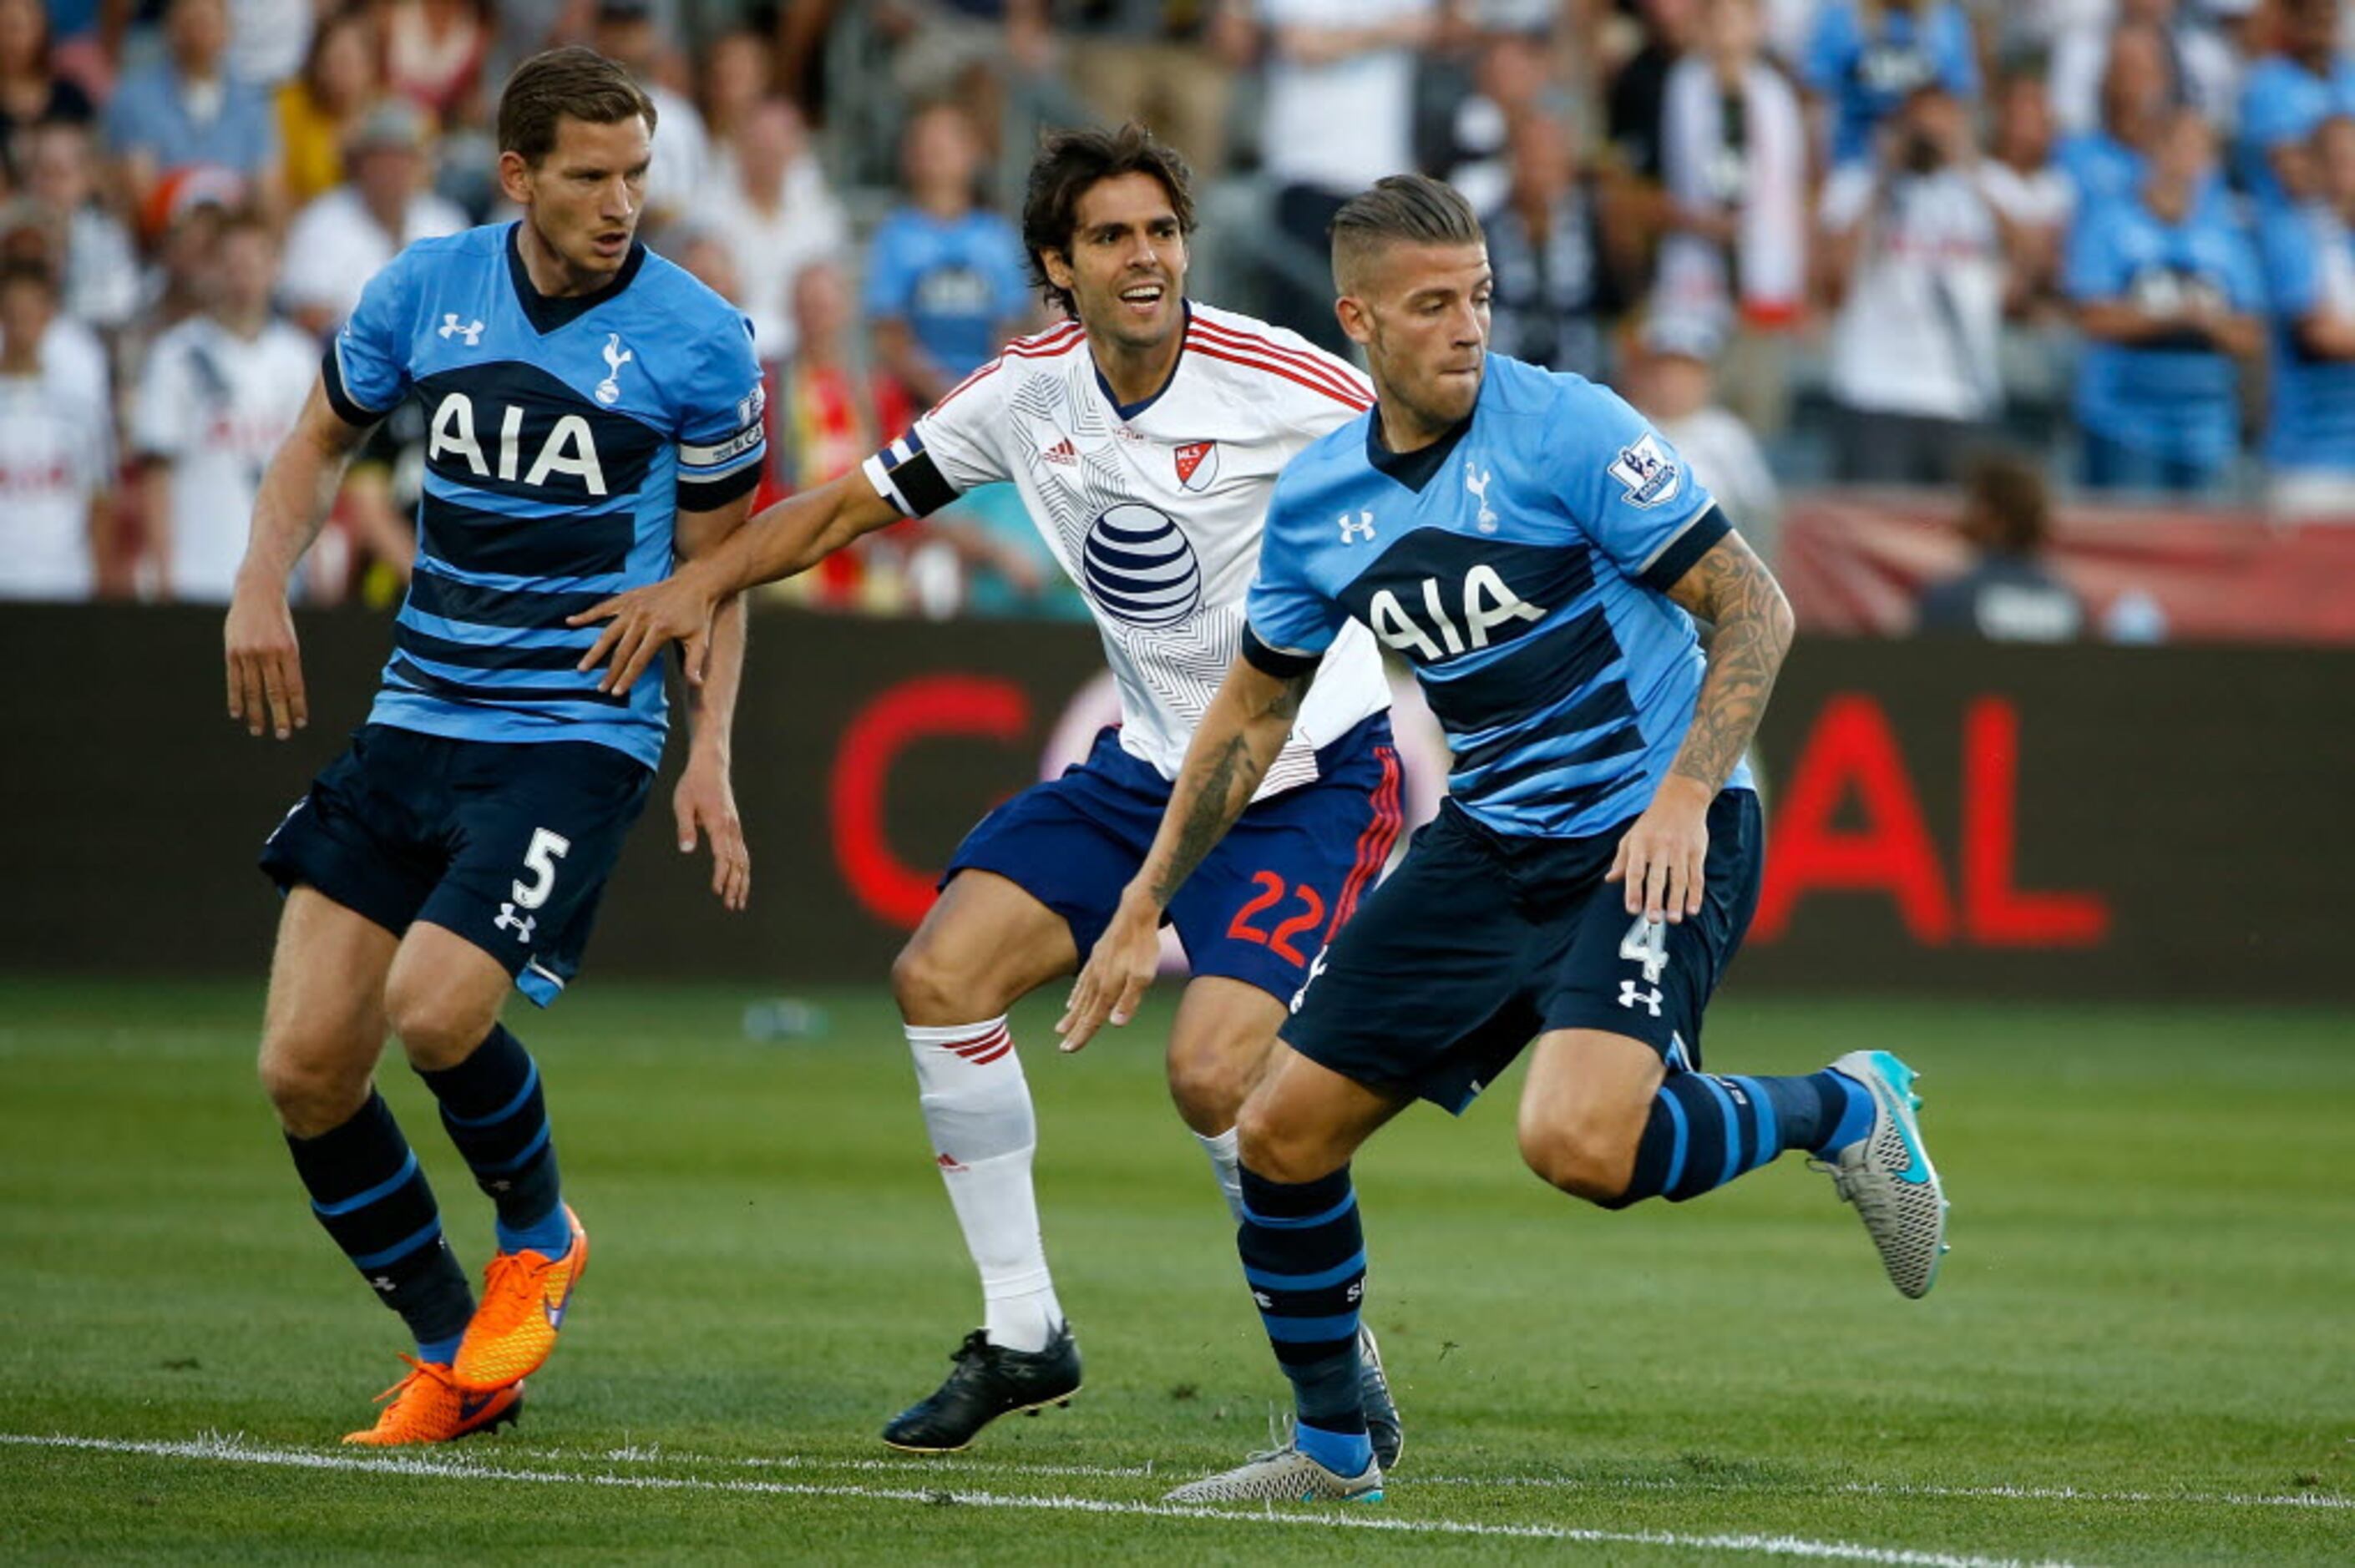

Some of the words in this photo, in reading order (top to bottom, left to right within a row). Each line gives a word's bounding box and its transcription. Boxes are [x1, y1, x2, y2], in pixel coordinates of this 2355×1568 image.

[429, 392, 607, 495] AIA
[1177, 446, 1200, 460] MLS
[1370, 564, 1547, 660] AIA
[512, 827, 571, 909] 5
[1226, 870, 1325, 969] 22
[1618, 908, 1669, 985] 4
